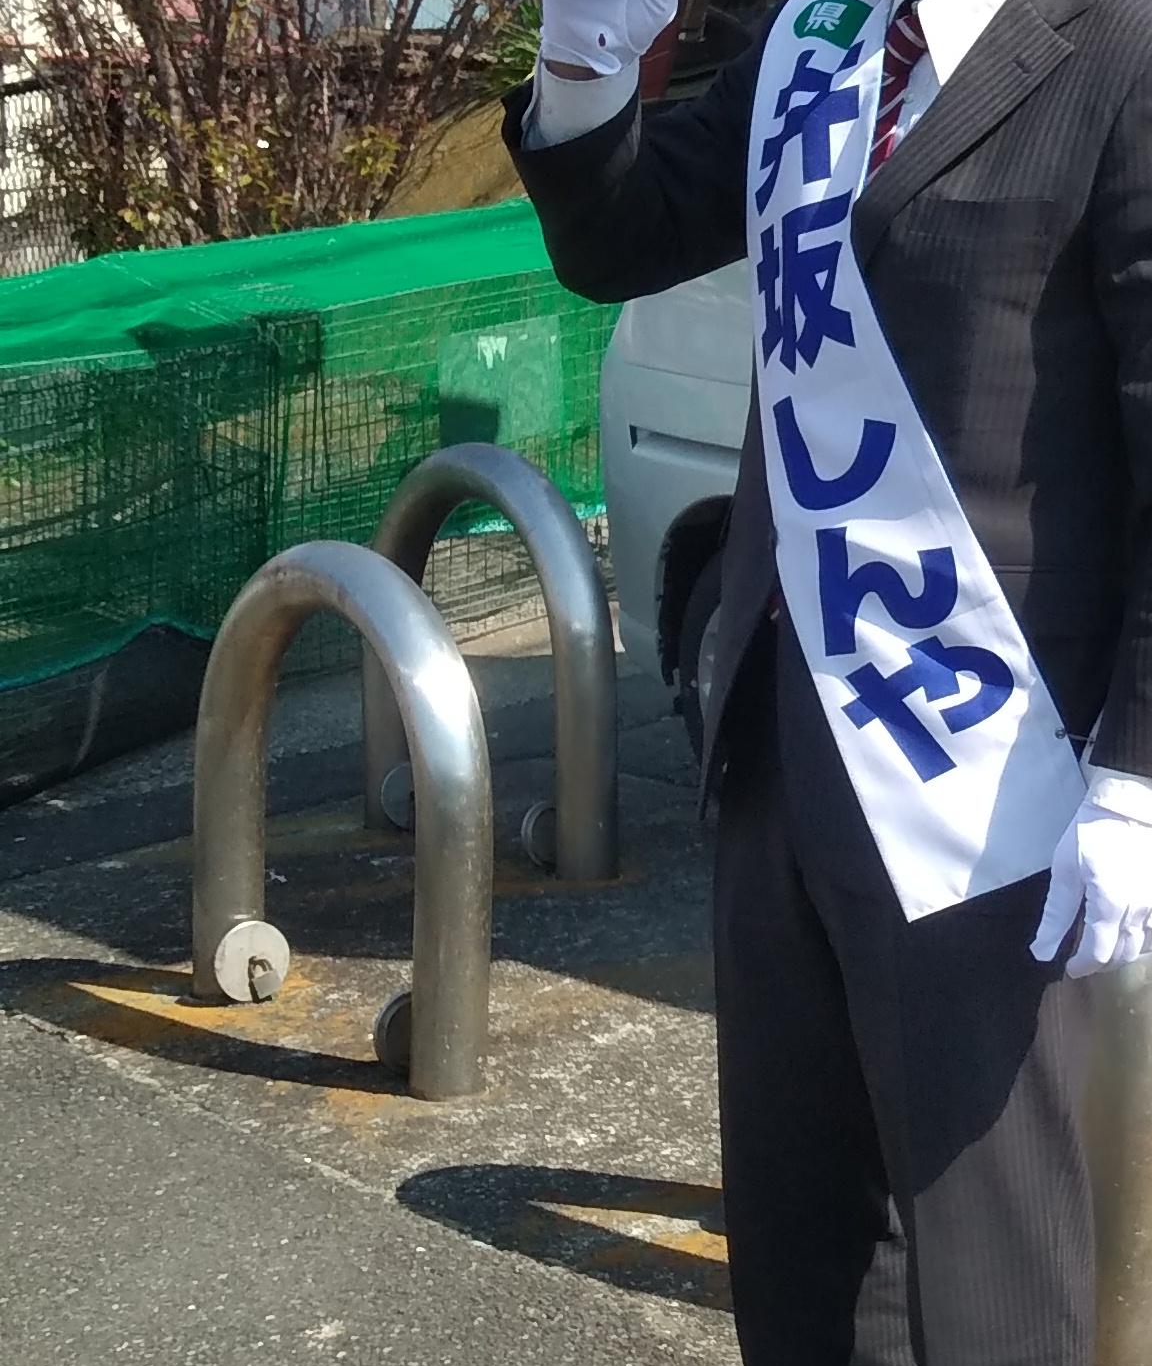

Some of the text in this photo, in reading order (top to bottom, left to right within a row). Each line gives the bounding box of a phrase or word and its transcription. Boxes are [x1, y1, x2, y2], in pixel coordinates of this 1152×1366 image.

[755, 39, 1015, 784] 井坂しんや
